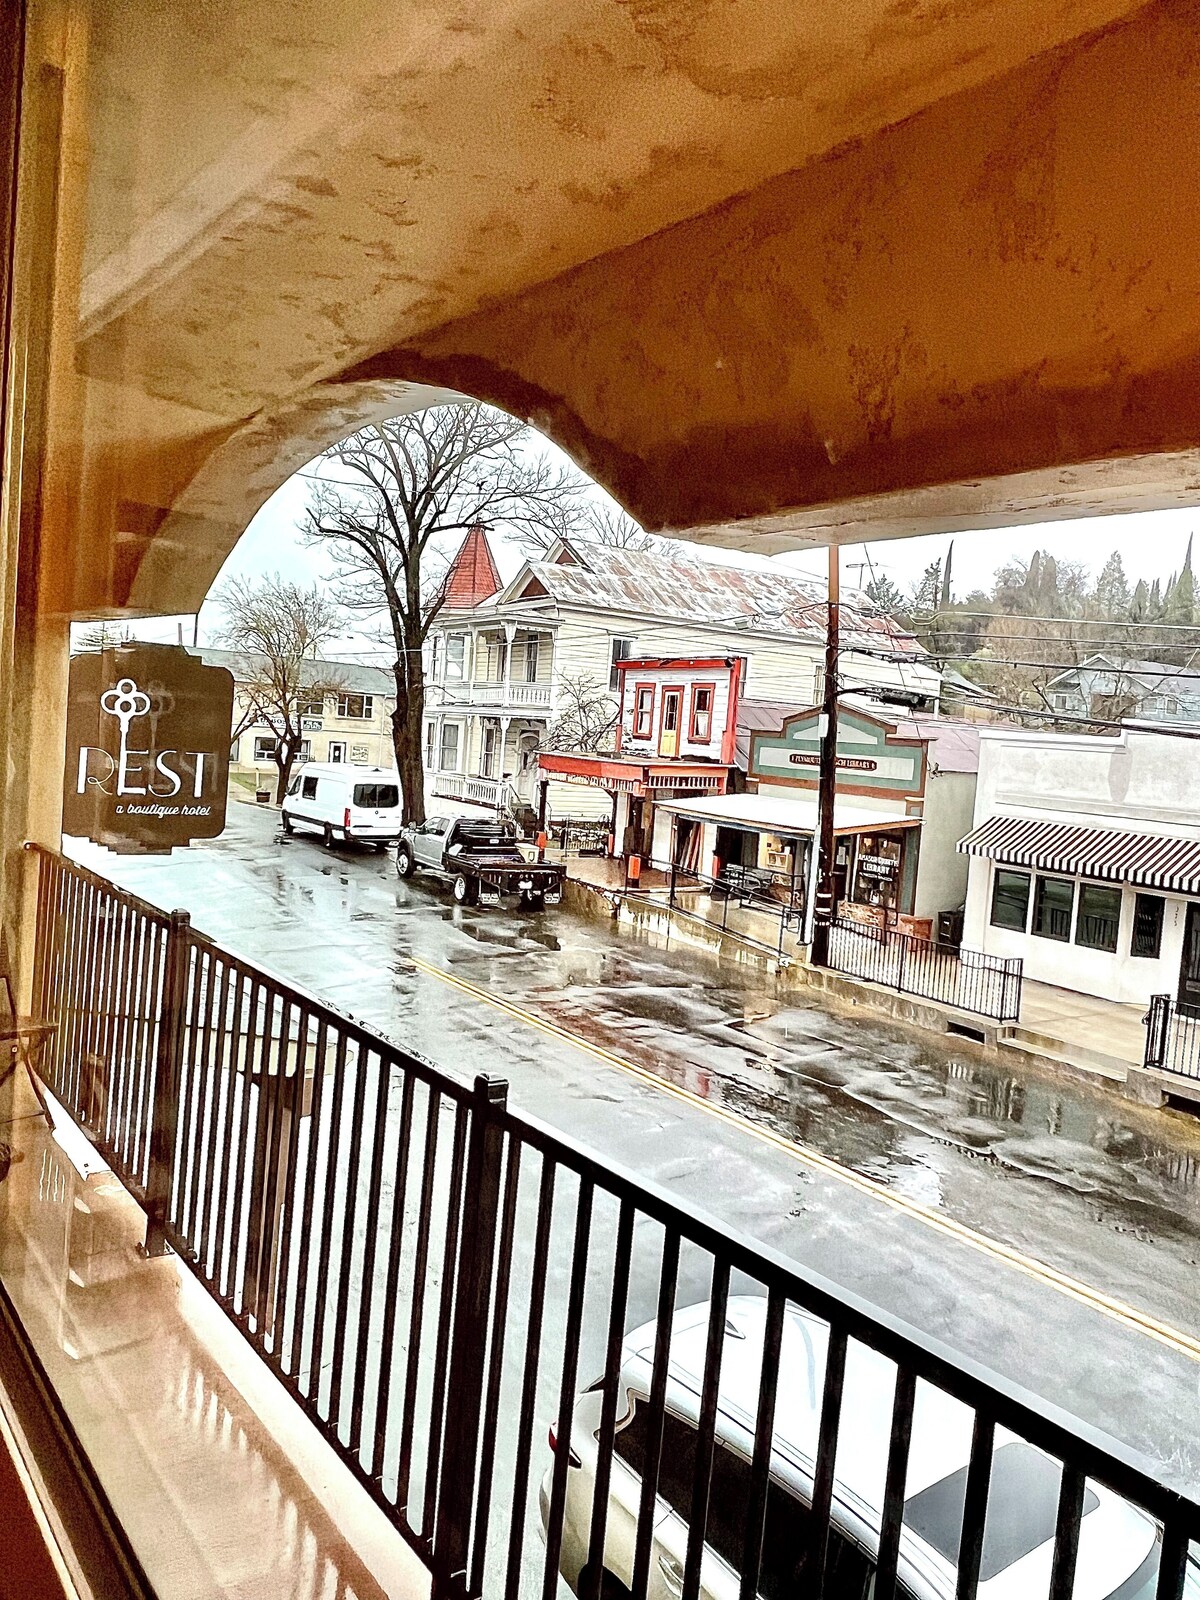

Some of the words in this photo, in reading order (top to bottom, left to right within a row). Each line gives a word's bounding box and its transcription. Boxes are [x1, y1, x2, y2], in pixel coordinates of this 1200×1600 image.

[847, 760, 869, 768] LIBRARY
[77, 746, 214, 798] REST
[115, 805, 124, 814] a
[127, 803, 179, 818] boutique
[181, 804, 211, 816] hotel
[863, 862, 890, 875] LIBRARY
